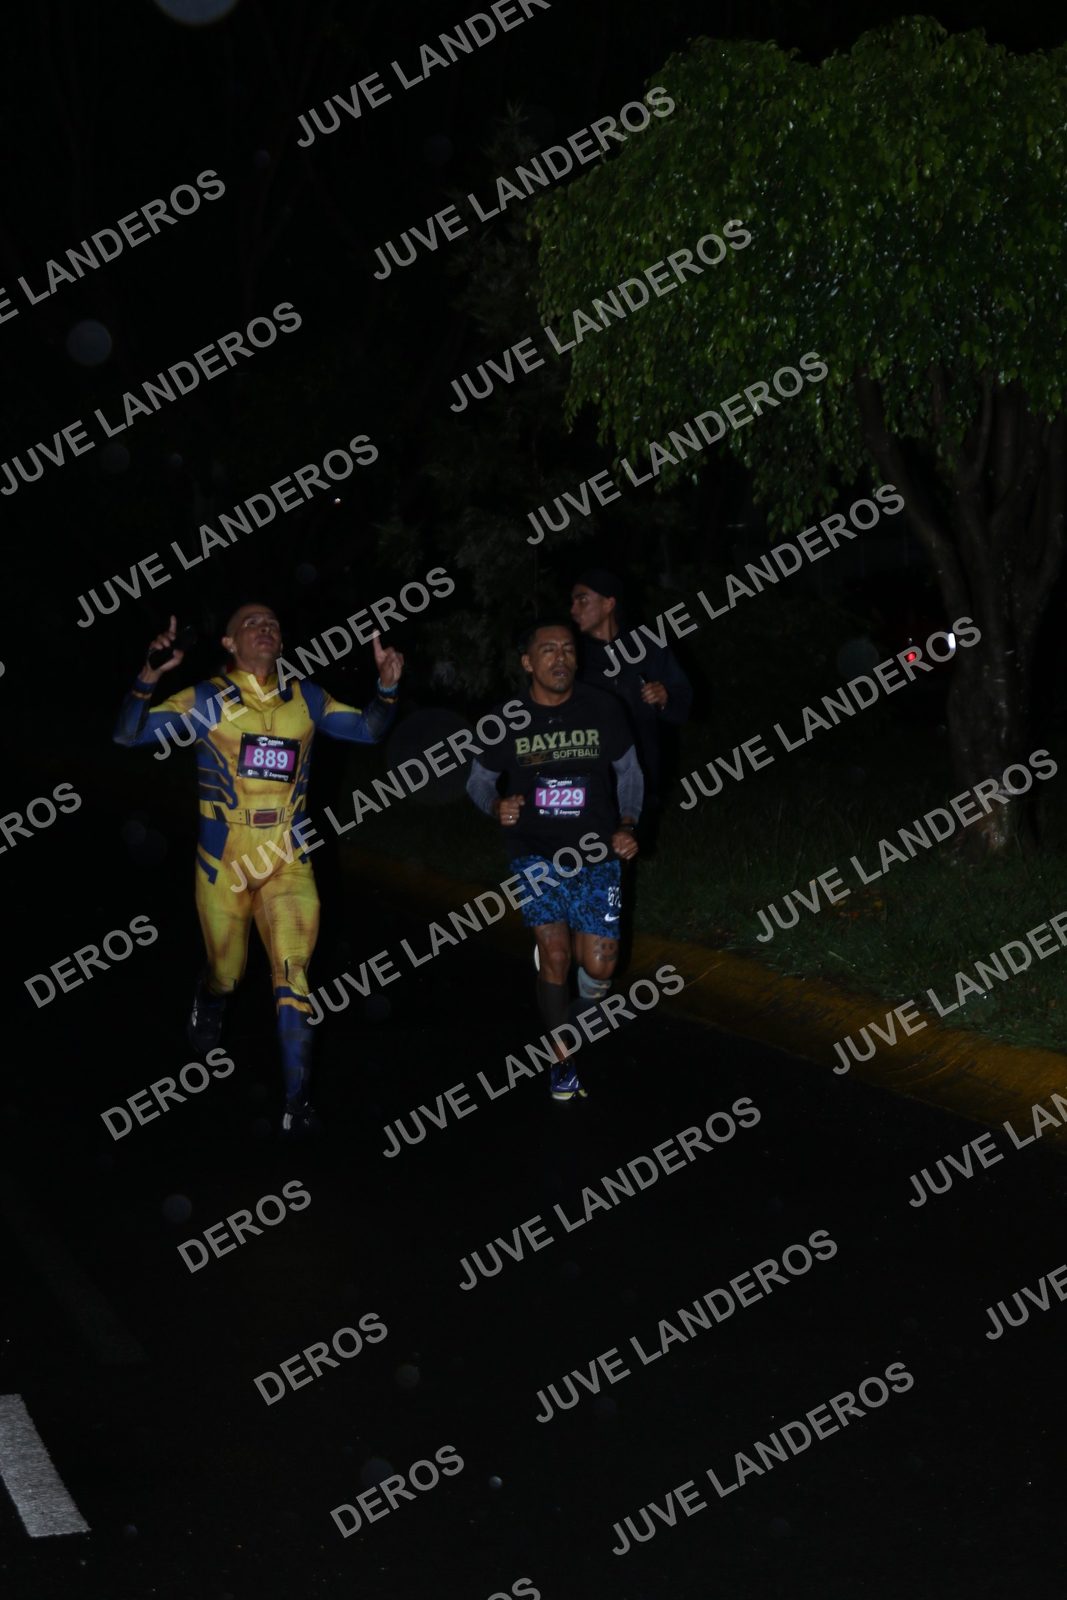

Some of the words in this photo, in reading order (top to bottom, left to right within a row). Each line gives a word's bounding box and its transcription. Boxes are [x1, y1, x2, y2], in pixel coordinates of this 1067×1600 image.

[515, 729, 600, 755] BAYLOR
[252, 748, 288, 769] 889
[552, 747, 600, 760] SOFTBALL
[538, 789, 584, 806] 1229
